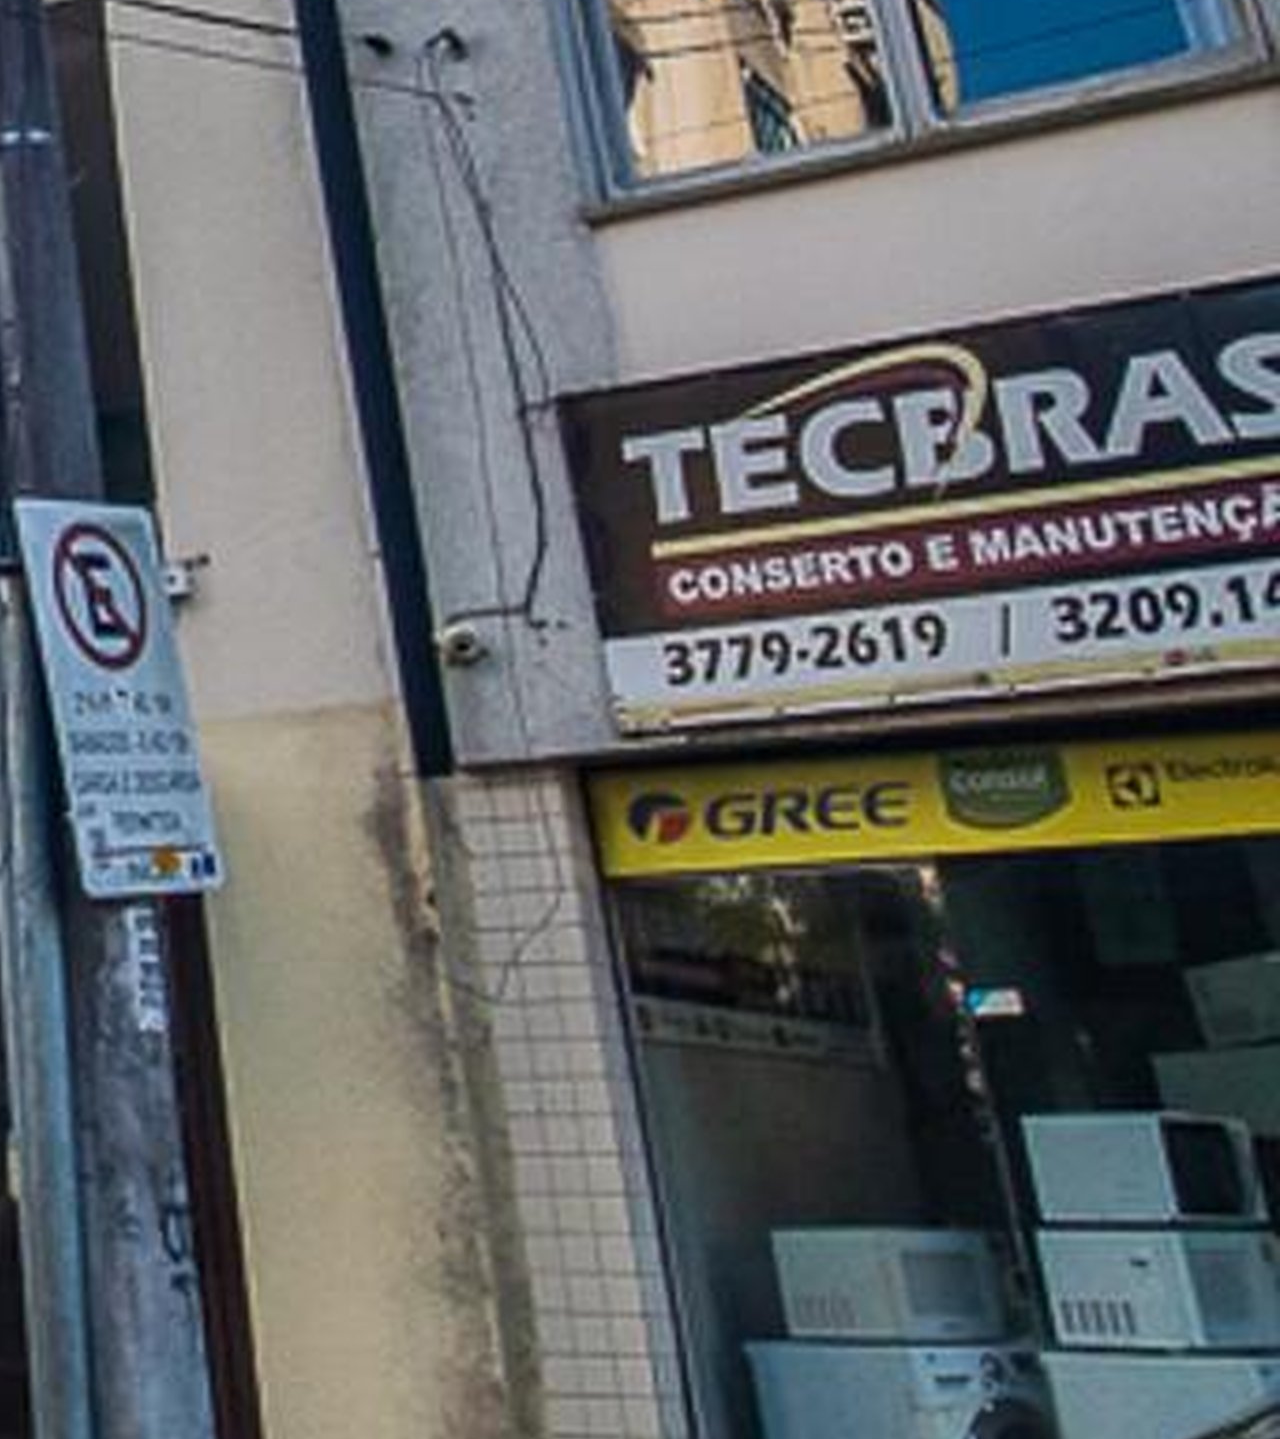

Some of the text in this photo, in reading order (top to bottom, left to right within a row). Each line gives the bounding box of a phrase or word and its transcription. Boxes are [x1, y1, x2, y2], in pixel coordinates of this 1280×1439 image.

[623, 330, 1280, 524] TECBRAS
[668, 541, 914, 605] CONSERTO
[931, 534, 959, 571] E
[663, 613, 948, 688] 3779-2619
[705, 778, 915, 842] GREE
